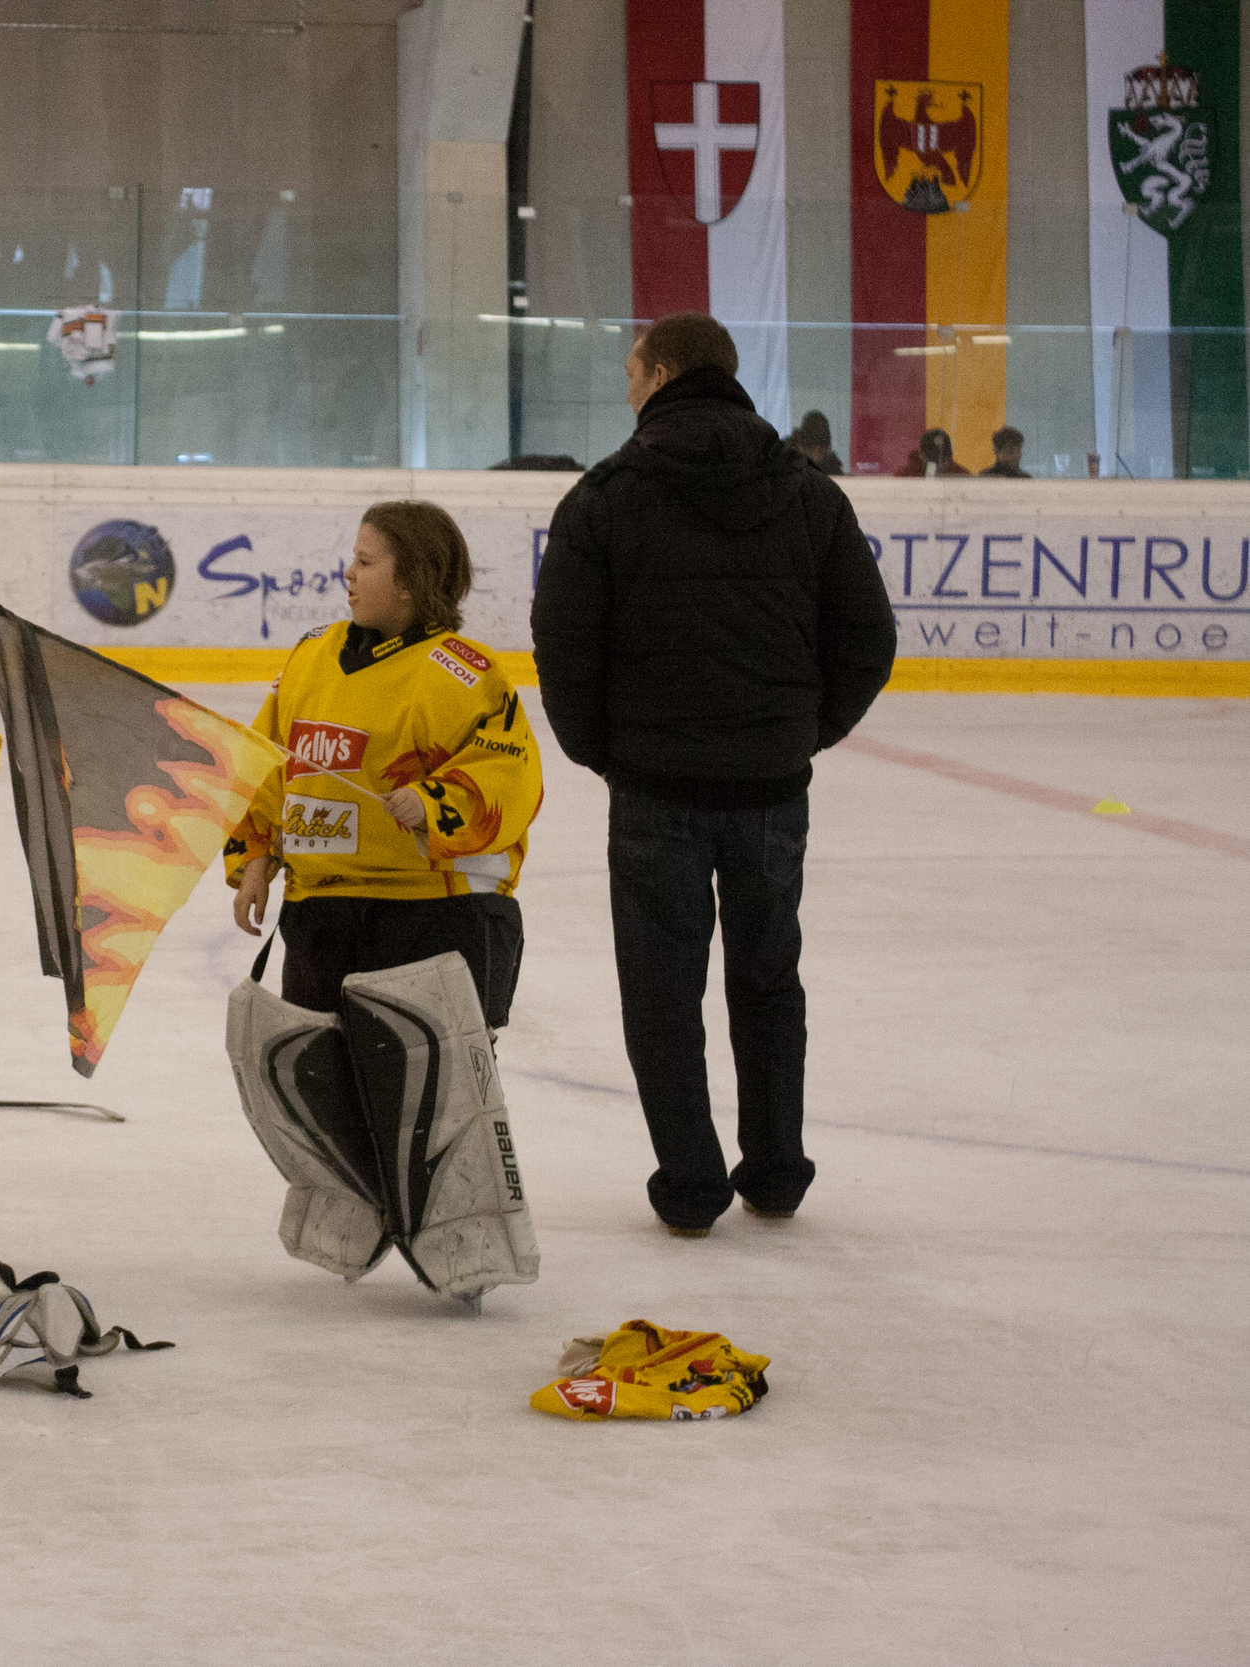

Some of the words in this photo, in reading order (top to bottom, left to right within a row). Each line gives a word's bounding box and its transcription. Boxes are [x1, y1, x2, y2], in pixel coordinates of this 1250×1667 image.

[431, 649, 477, 685] RICOH
[446, 639, 477, 660] ASKO
[294, 729, 352, 768] Kelly's
[493, 1120, 523, 1201] BAUER
